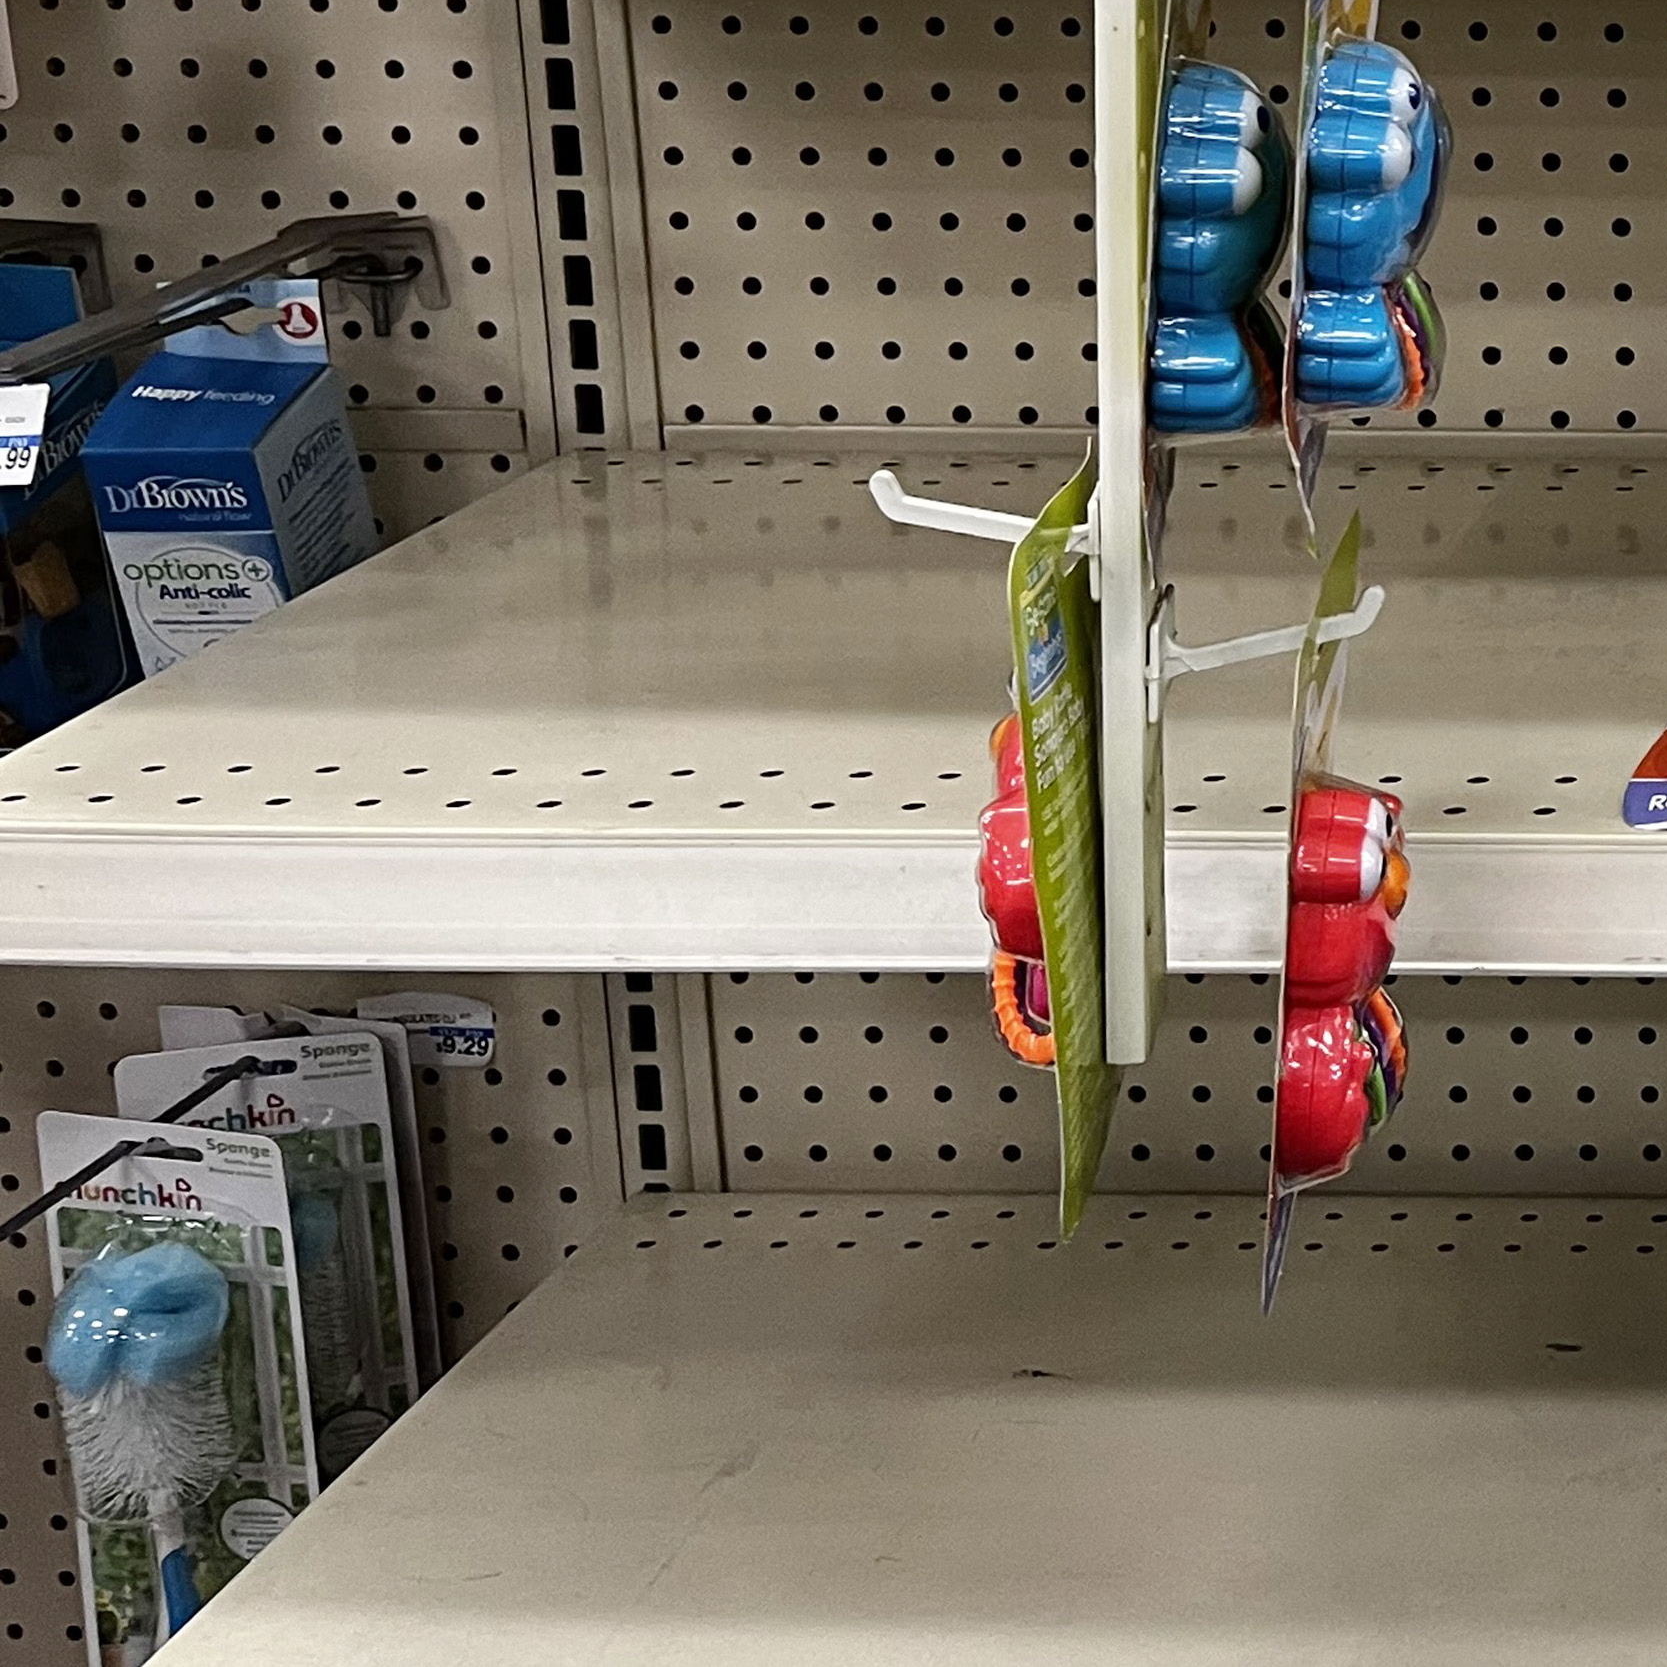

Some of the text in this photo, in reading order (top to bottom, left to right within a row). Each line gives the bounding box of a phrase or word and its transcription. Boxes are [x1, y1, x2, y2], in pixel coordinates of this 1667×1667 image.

[123, 556, 240, 587] options
[159, 582, 251, 600] Anti-colic
[435, 1034, 491, 1057] $9.29
